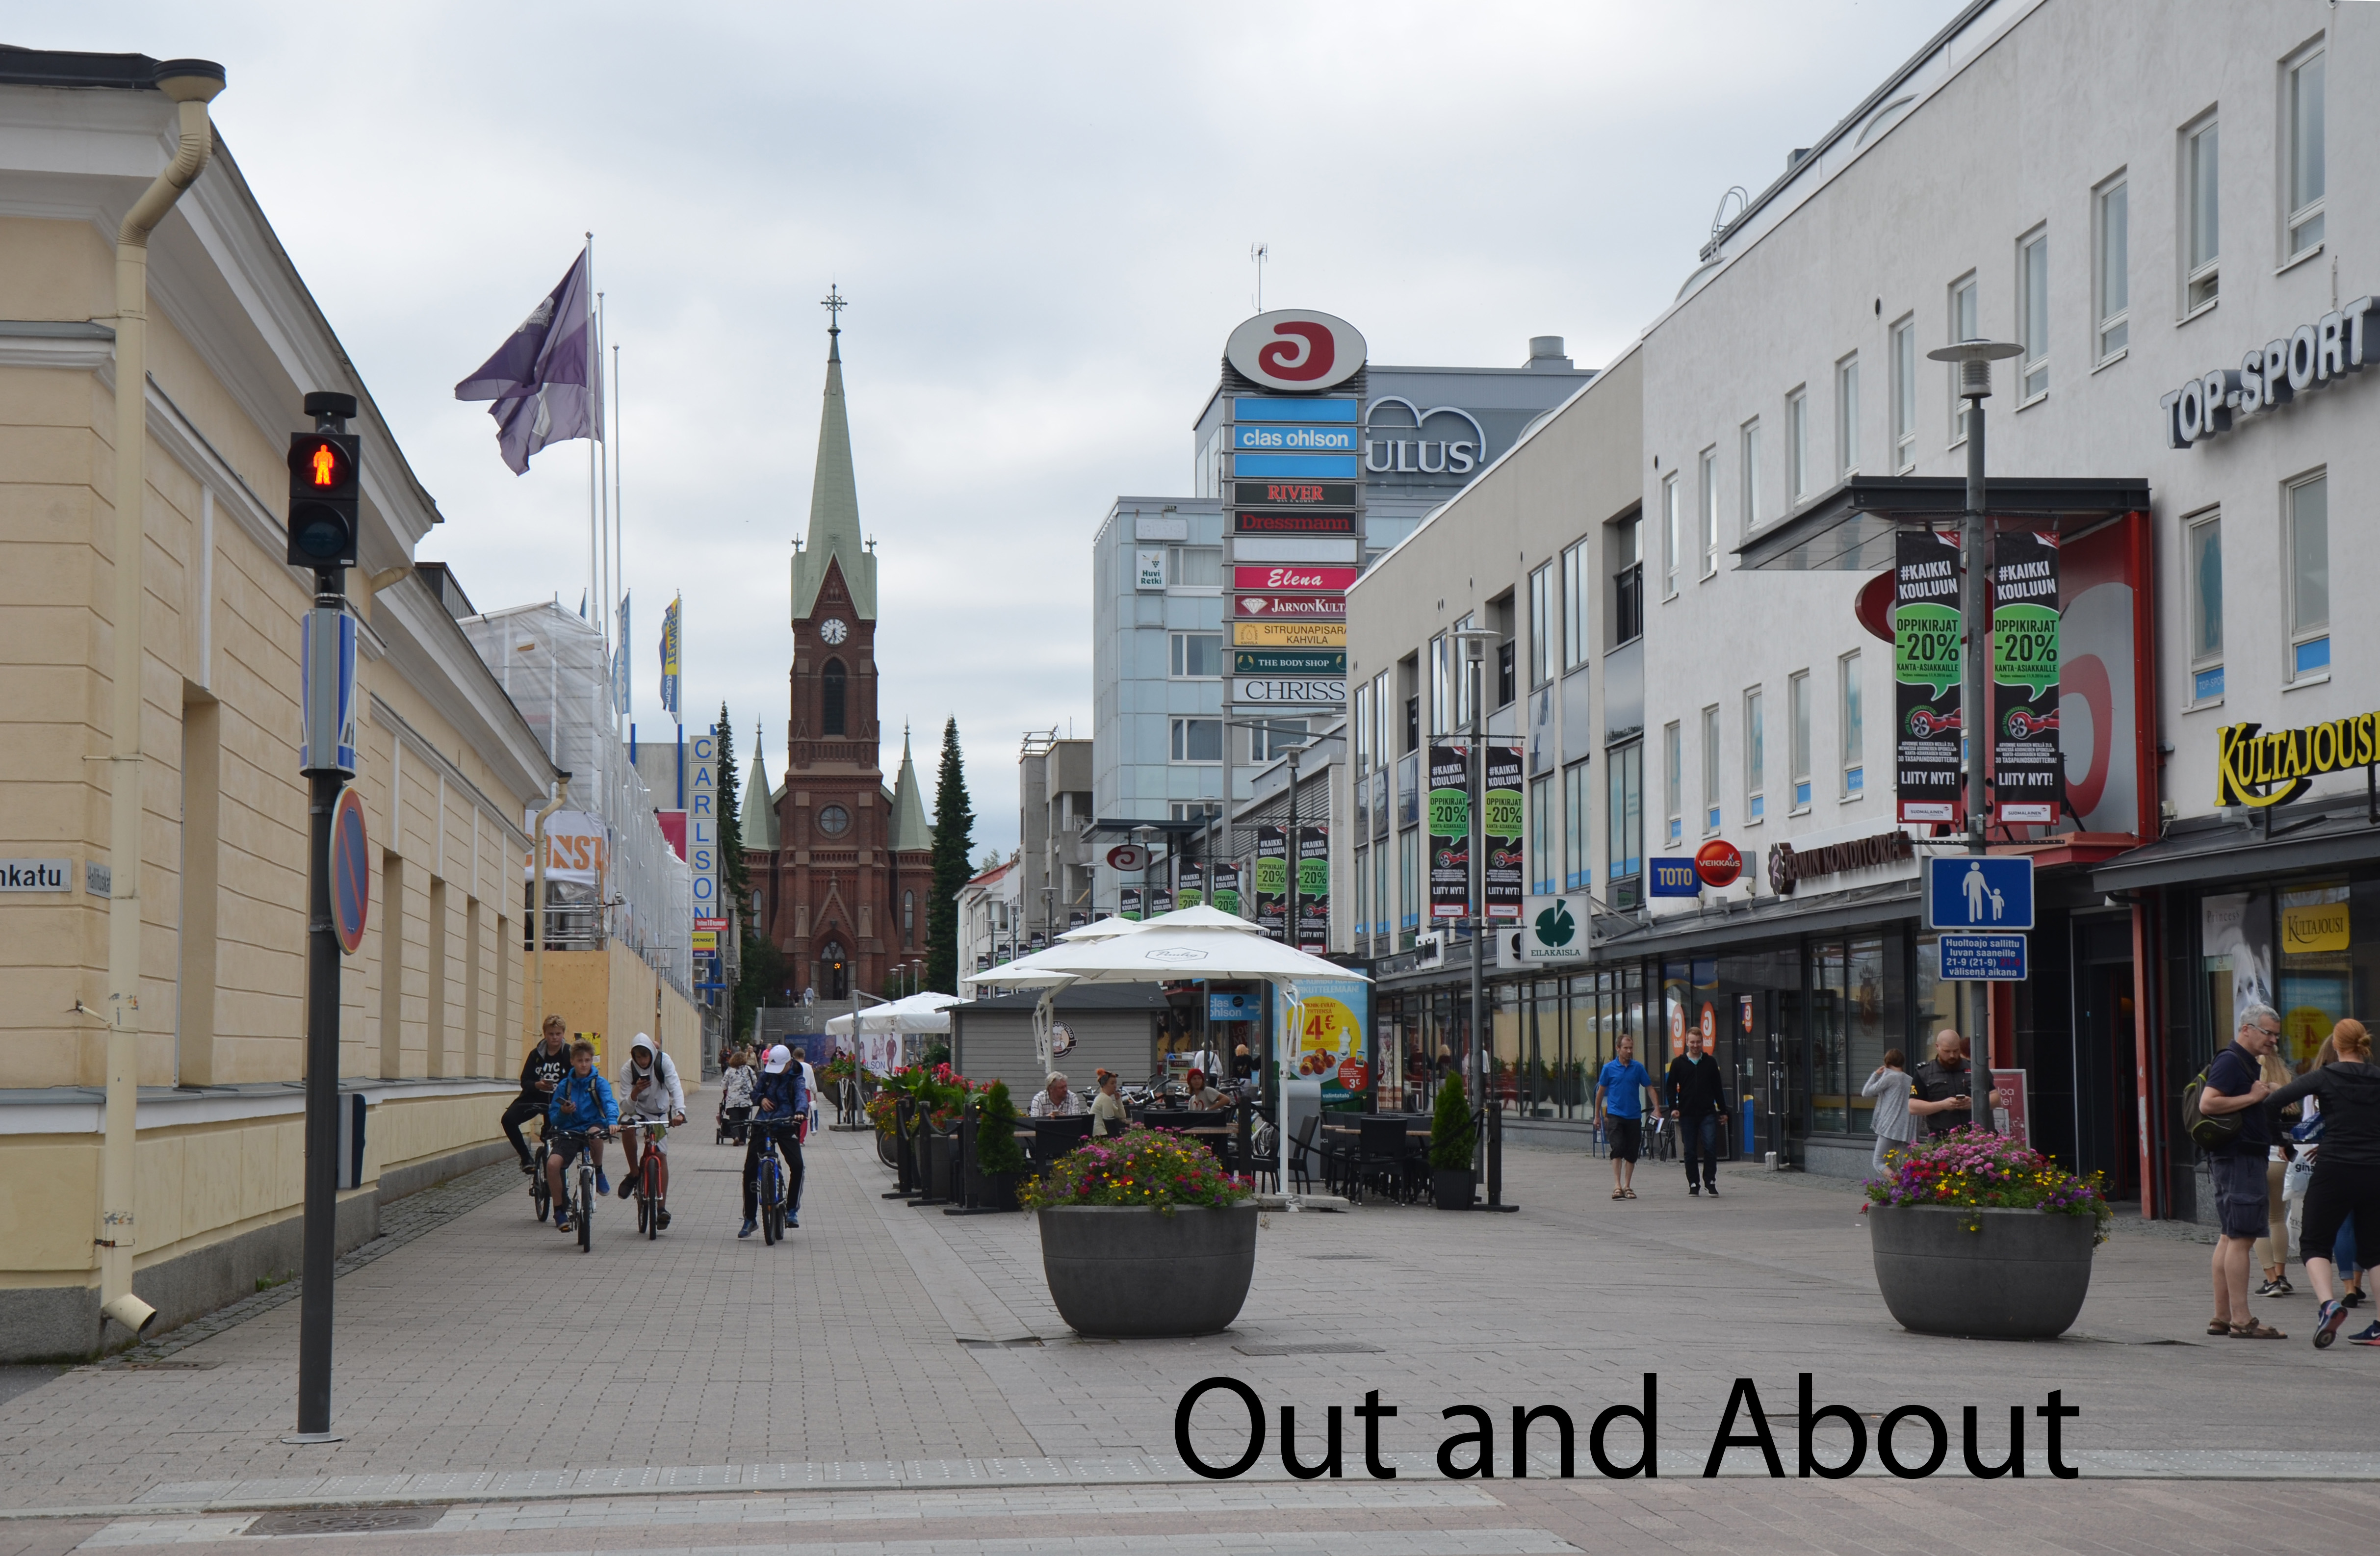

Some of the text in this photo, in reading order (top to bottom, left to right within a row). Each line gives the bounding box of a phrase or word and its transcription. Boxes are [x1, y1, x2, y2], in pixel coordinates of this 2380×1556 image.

[2160, 295, 2371, 449] TOP-SPORT
[1243, 429, 1348, 447] clas ohlson
[1366, 440, 1474, 474] ULUS
[1268, 485, 1324, 500] RIVER
[1242, 515, 1349, 530] Dressmann
[1900, 560, 1951, 581] #KAIKKI
[1999, 561, 2050, 581] #KAIKKI
[1268, 569, 1323, 587] Elena
[1899, 578, 1958, 599] KOULUUN
[1997, 578, 2056, 600] KOULUUN
[1897, 619, 1958, 632] OPPIKIRJAT
[1995, 620, 2056, 632] OPPIKIRJAT
[1287, 636, 1328, 644] KAHVILA
[1896, 633, 1959, 661] -20%
[1994, 634, 2057, 662] -20%
[1897, 663, 1959, 672] KANTA-ASIAKKAILLE
[1246, 681, 1345, 700] CHRISS
[1432, 764, 1462, 776] #KAIKKI
[1489, 764, 1518, 776] #KAIKKI
[1431, 774, 1466, 787] KOULUUN
[1488, 775, 1522, 787] KOULUUN
[1901, 771, 1955, 785] LIITY NYT!
[1999, 773, 2053, 785] LIITY NYT!
[1430, 806, 1466, 822] -20%
[1486, 806, 1522, 823] -20%
[694, 739, 712, 918] CARLSON
[1260, 839, 1283, 847] #KAIKKI
[1302, 840, 1324, 849] #KAIKKI
[1259, 847, 1285, 856] KOULUUN
[1301, 848, 1327, 857] KOULUUN
[1785, 832, 1901, 881] RAMIN KONDITORIA
[1258, 870, 1285, 883] -20%
[1300, 872, 1327, 884] -20%
[1657, 868, 1692, 885] TOTO
[1505, 887, 1520, 895] NYT!
[1214, 901, 1237, 911] -20%
[2207, 910, 2239, 923] Princess
[2288, 915, 2343, 944] KULTAJOUSI
[1946, 939, 2019, 948] Huoltoajo sallittu
[1950, 948, 1973, 957] luvan
[1969, 959, 1996, 967] (21-9)
[1949, 967, 2017, 976] välisenä aikana
[1210, 998, 1229, 1007] clas
